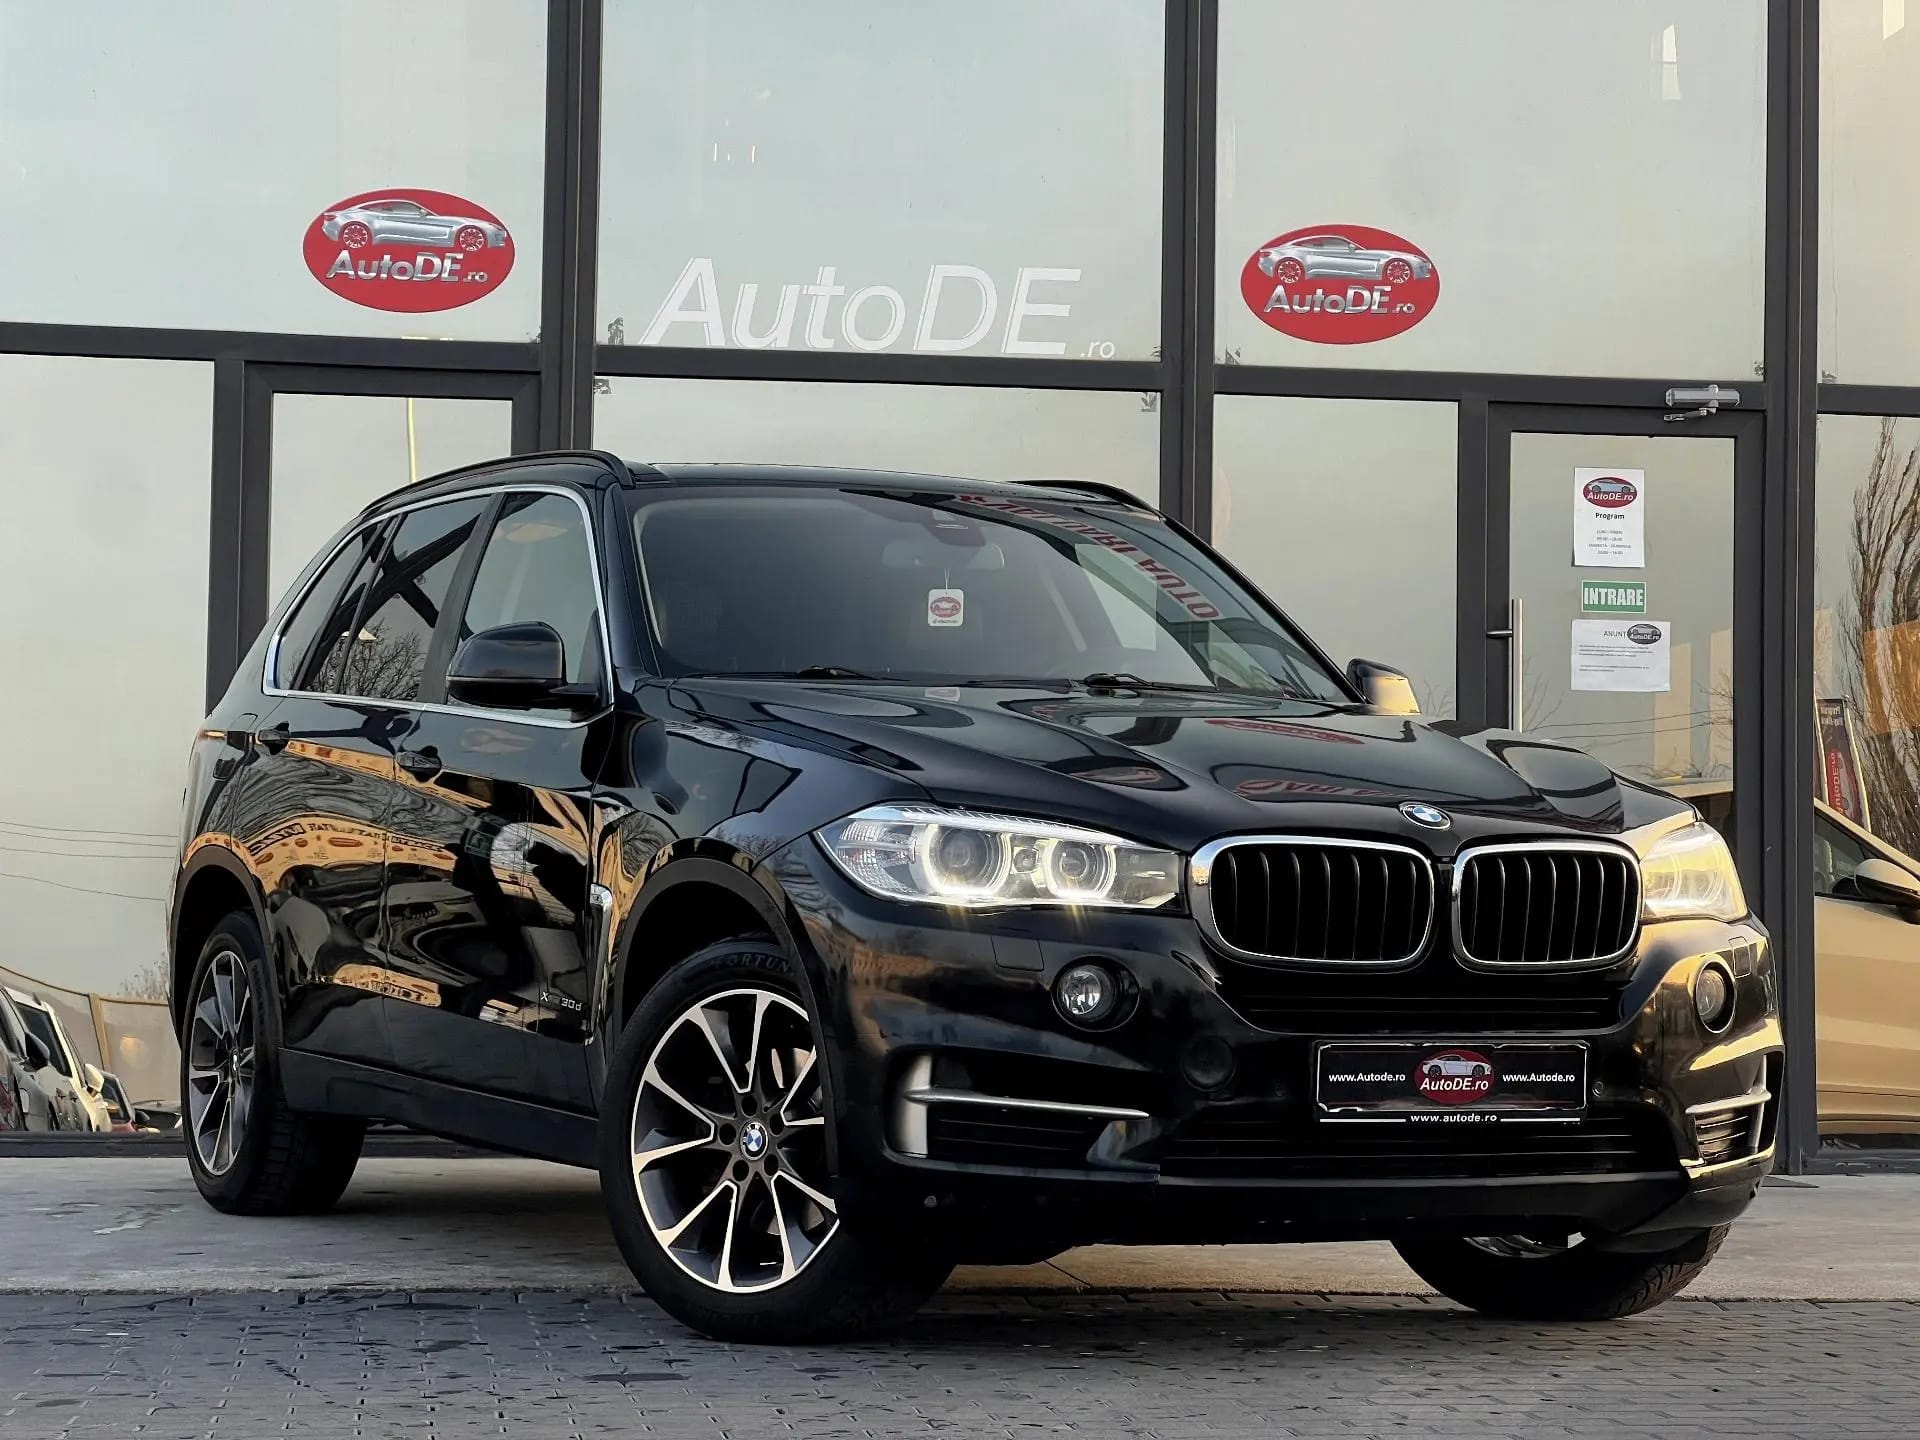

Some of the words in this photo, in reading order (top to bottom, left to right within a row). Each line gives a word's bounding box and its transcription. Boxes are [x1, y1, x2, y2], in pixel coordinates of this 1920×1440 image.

[1586, 492, 1634, 501] AutoDE.ro
[1595, 512, 1625, 521] Program
[1583, 587, 1644, 606] INTRARE
[561, 997, 583, 1011] 30d
[1328, 1071, 1406, 1083] www.Autode.ro
[1502, 1072, 1576, 1083] www.Autode.ro
[1420, 1077, 1489, 1092] AutoDE.ro
[1410, 1113, 1498, 1123] www.autode.ro
